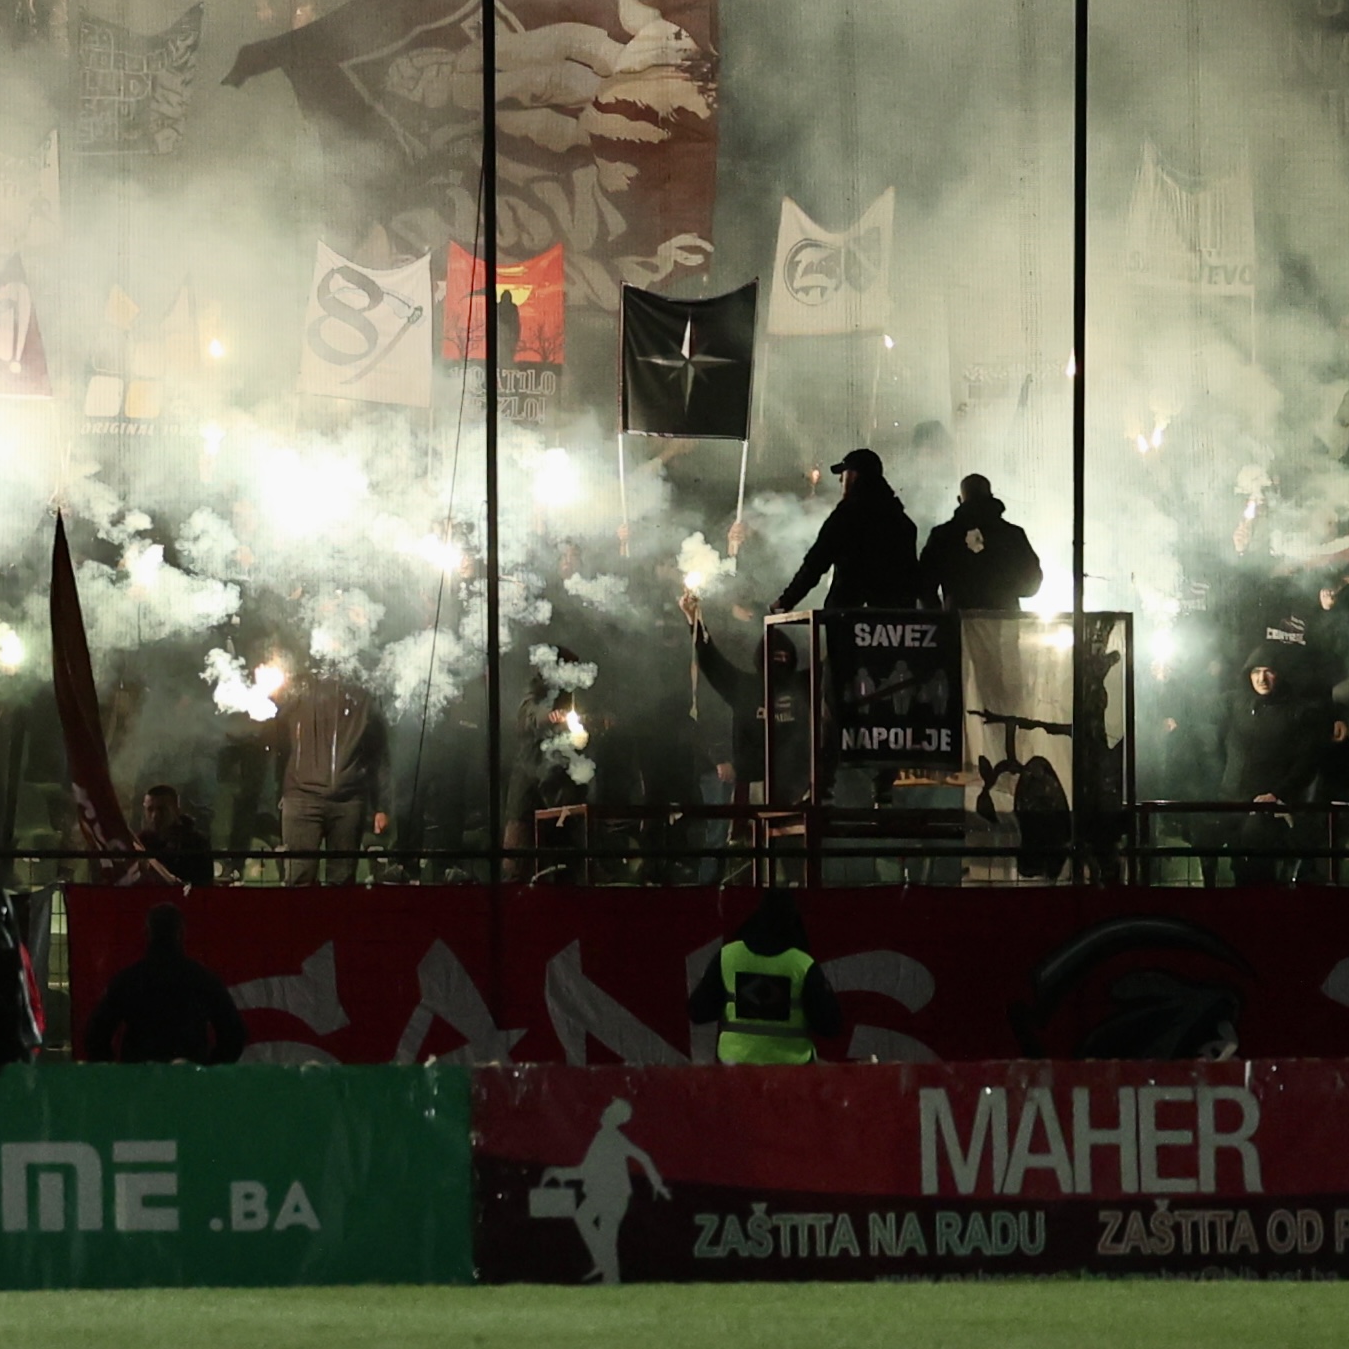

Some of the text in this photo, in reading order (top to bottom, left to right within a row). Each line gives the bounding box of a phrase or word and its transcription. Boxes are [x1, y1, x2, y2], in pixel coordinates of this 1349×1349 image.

[853, 621, 938, 648] SAVEZ
[840, 726, 952, 753] NAPOLJE
[919, 1086, 1265, 1196] MAHER
[693, 1201, 1047, 1259] ZAŠTITA NA RADU
[1097, 1197, 1259, 1256] ZAŠTITA
[1266, 1208, 1325, 1255] OD
